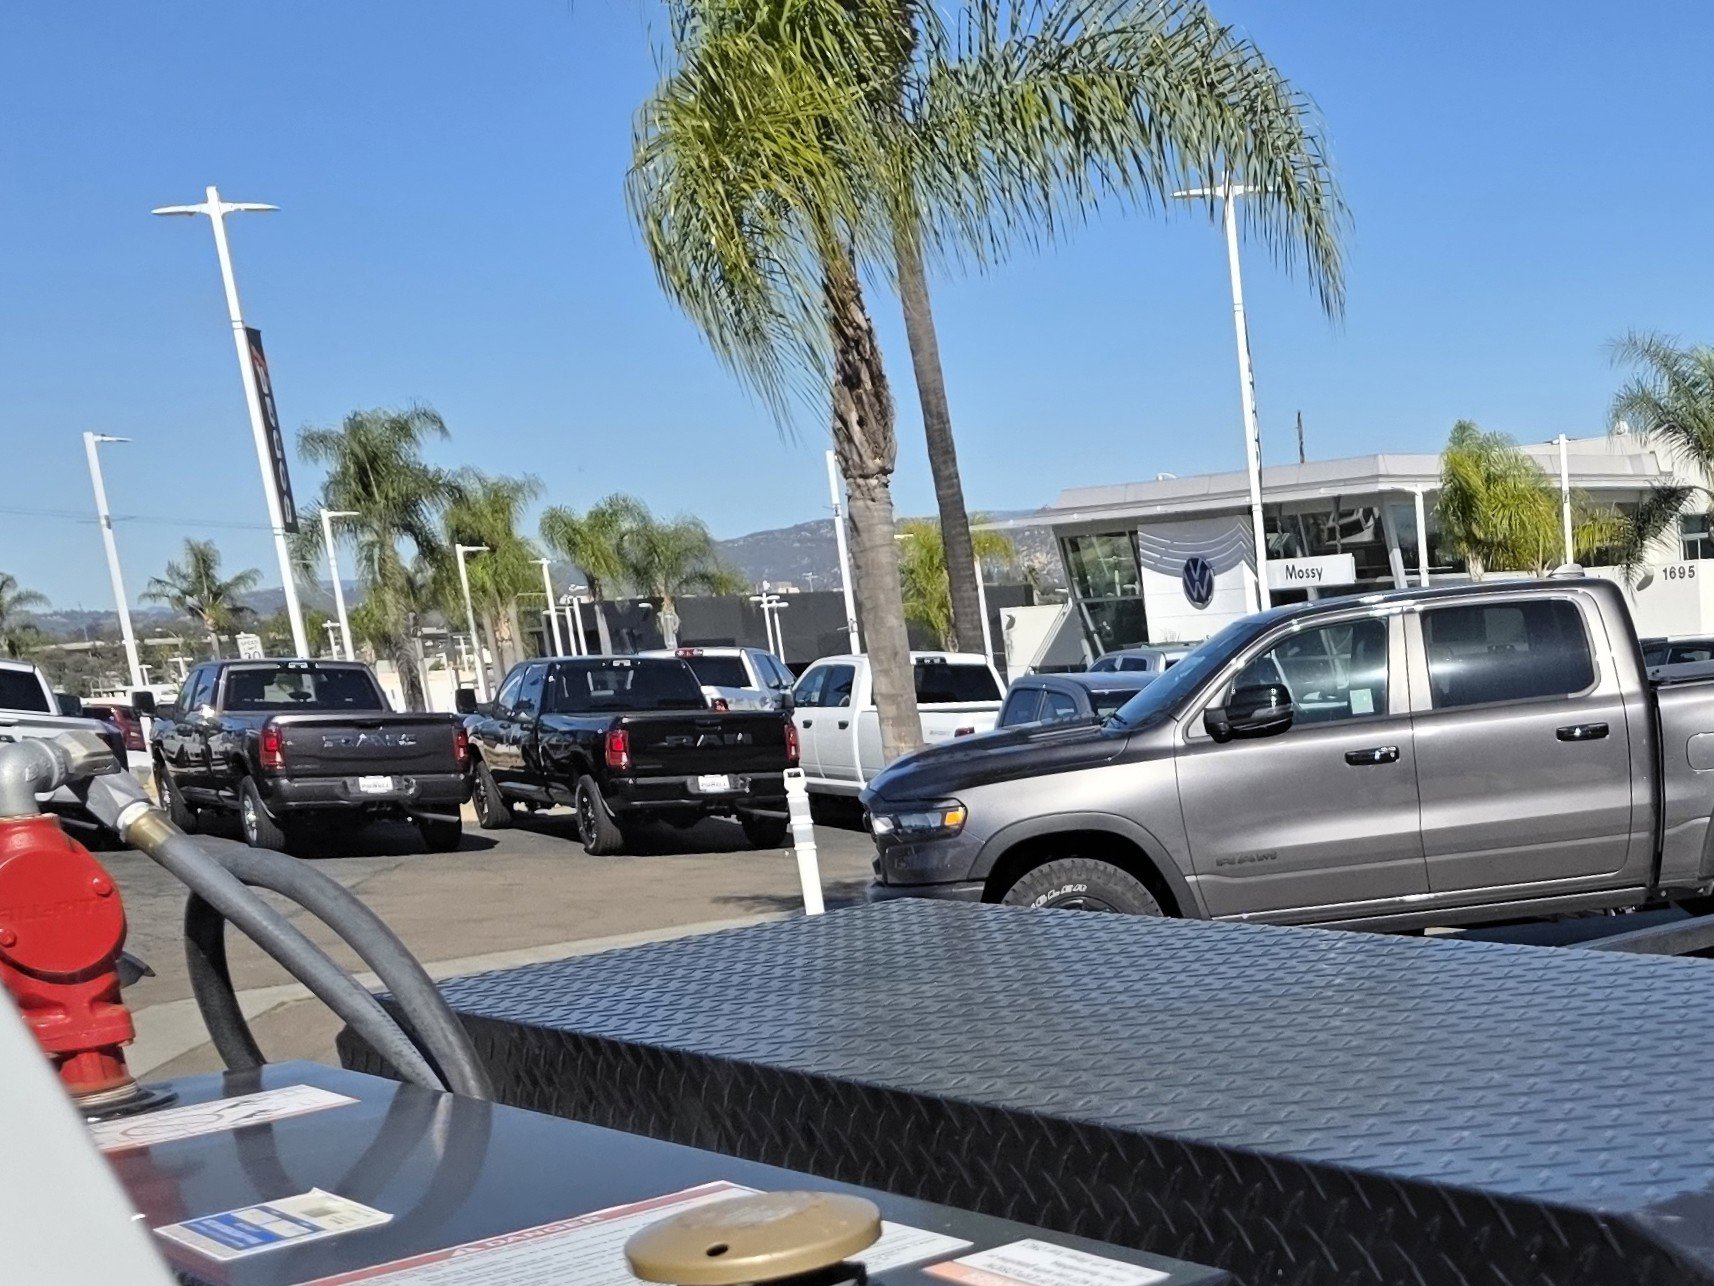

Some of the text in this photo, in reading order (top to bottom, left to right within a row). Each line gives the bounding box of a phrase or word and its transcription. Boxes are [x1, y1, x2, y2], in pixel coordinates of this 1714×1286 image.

[1285, 564, 1323, 581] Mossy
[1662, 564, 1696, 581] 1695
[1215, 851, 1279, 867] RAM
[486, 1216, 606, 1246] DANGER
